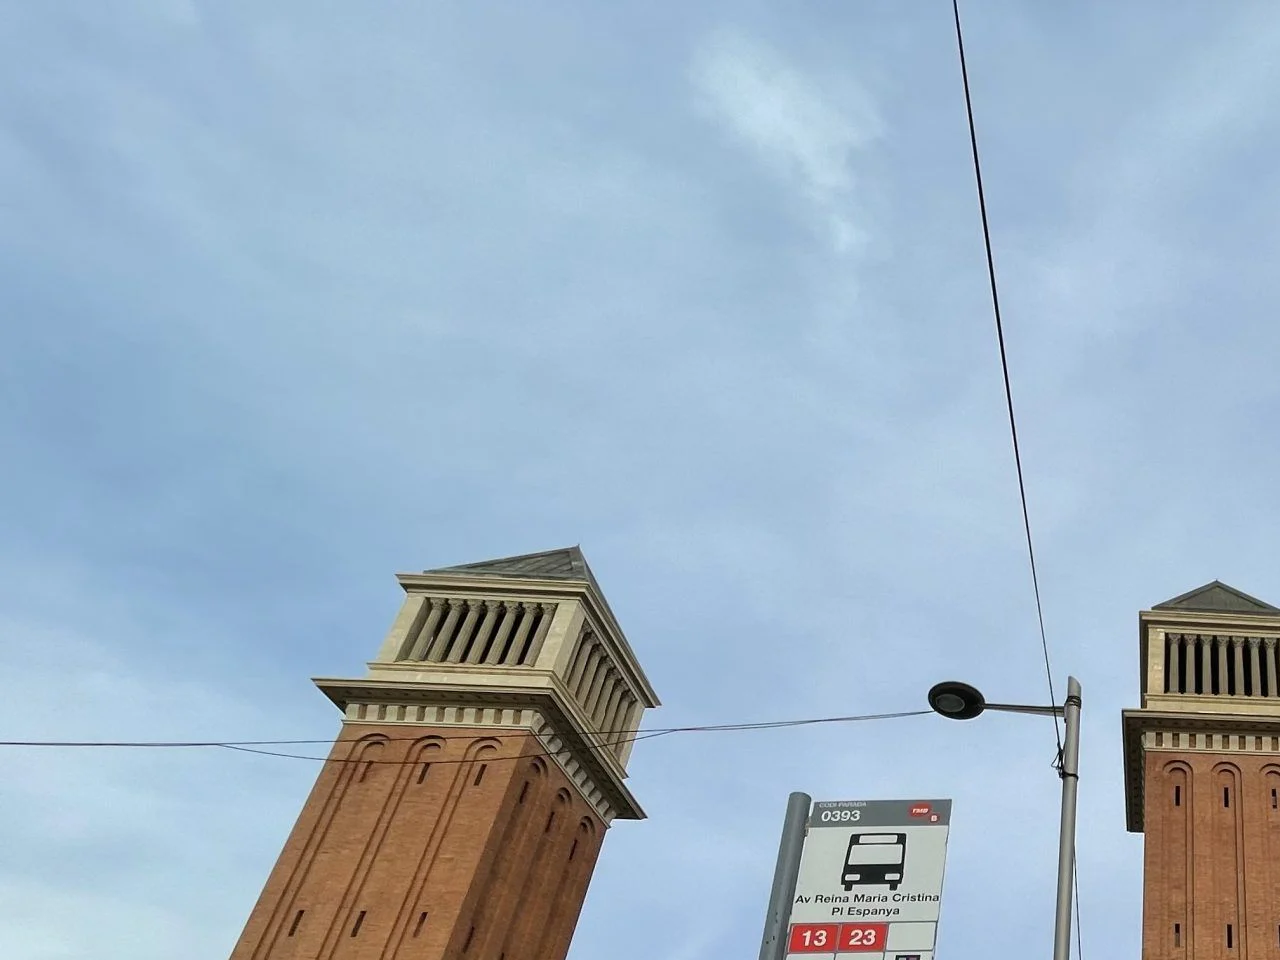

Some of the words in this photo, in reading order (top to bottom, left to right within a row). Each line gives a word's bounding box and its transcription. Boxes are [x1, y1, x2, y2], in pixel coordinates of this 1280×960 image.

[821, 810, 861, 822] 0393
[795, 895, 811, 904] Av
[814, 894, 850, 904] Reina
[853, 894, 888, 903] Maria
[892, 893, 940, 903] Cristina
[831, 907, 844, 916] Pl
[847, 906, 900, 918] Espanya
[801, 930, 827, 947] 13
[848, 929, 876, 946] 23
